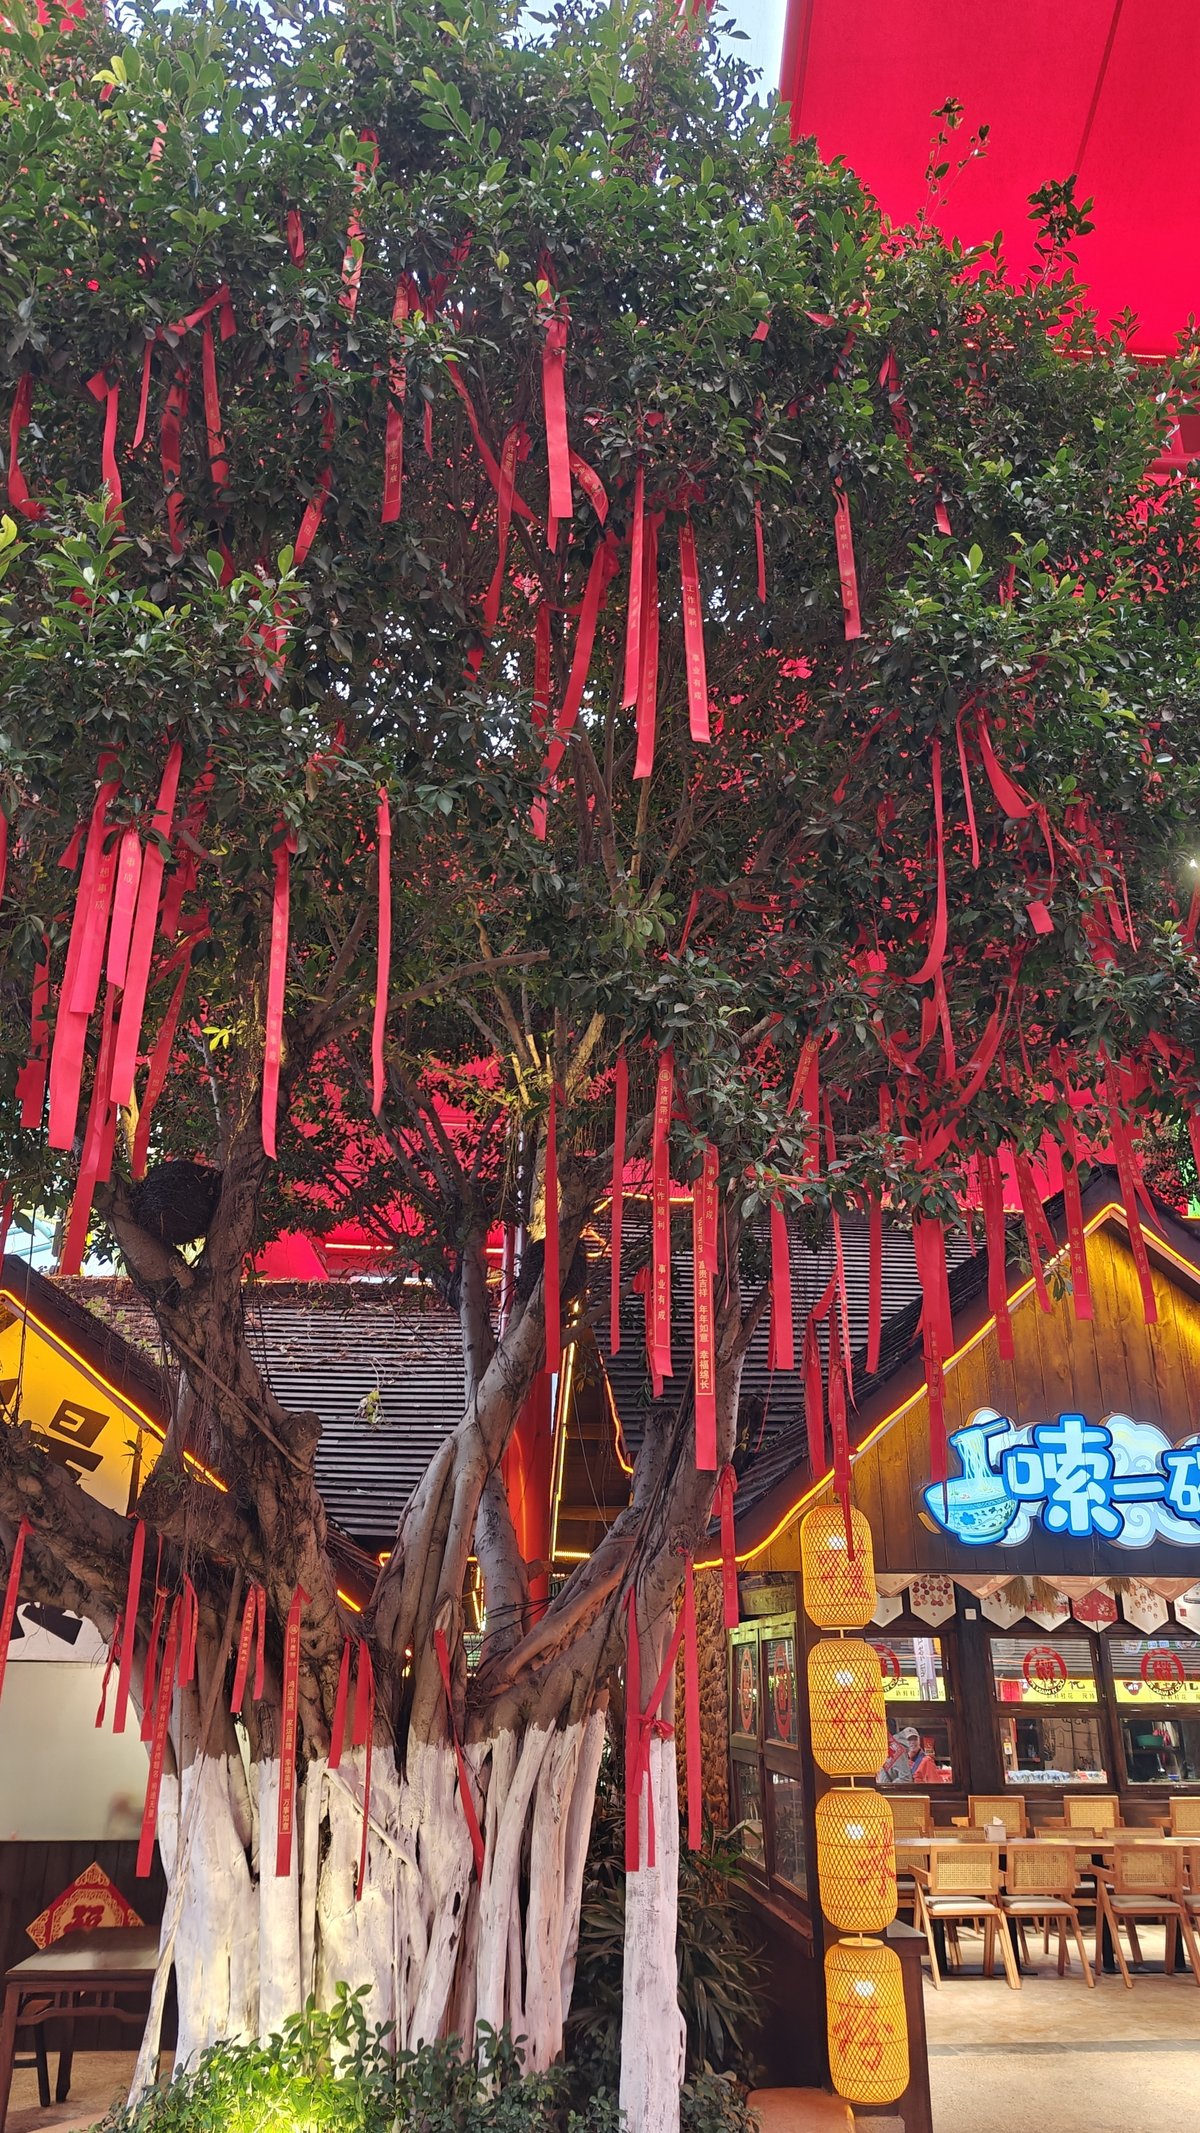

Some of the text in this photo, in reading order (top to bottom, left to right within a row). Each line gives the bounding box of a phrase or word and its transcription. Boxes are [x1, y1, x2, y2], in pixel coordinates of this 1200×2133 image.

[687, 583, 703, 701] 工作顺利 事业有成
[659, 1085, 669, 1116] 许愿带
[656, 1177, 666, 1231] 工作顺利
[705, 1165, 715, 1221] 事业有成
[1071, 1226, 1084, 1275] 事业有成
[657, 1263, 667, 1321] 事业有成
